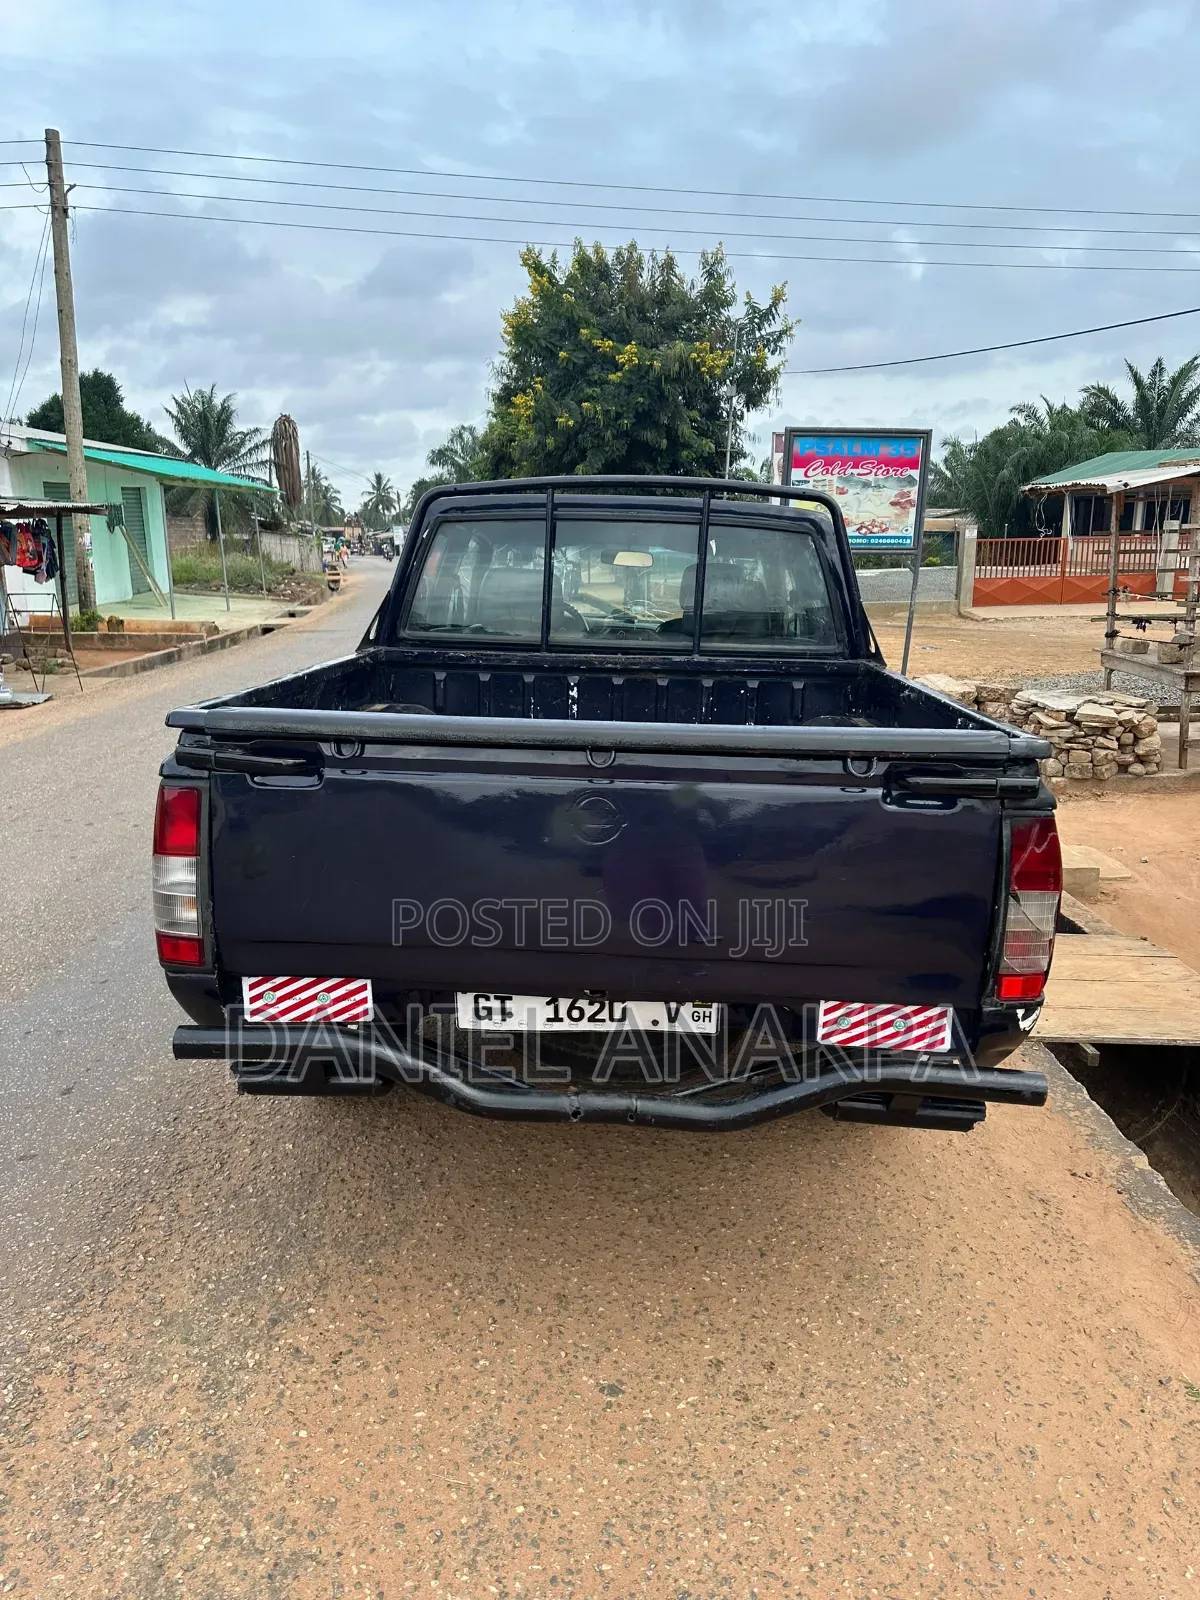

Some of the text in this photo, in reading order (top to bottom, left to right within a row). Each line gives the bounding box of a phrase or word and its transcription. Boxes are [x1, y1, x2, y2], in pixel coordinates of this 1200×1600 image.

[800, 439, 916, 457] PSALM 35
[803, 459, 910, 478] Cold Store
[473, 994, 513, 1022] GT
[691, 1010, 712, 1023] GH
